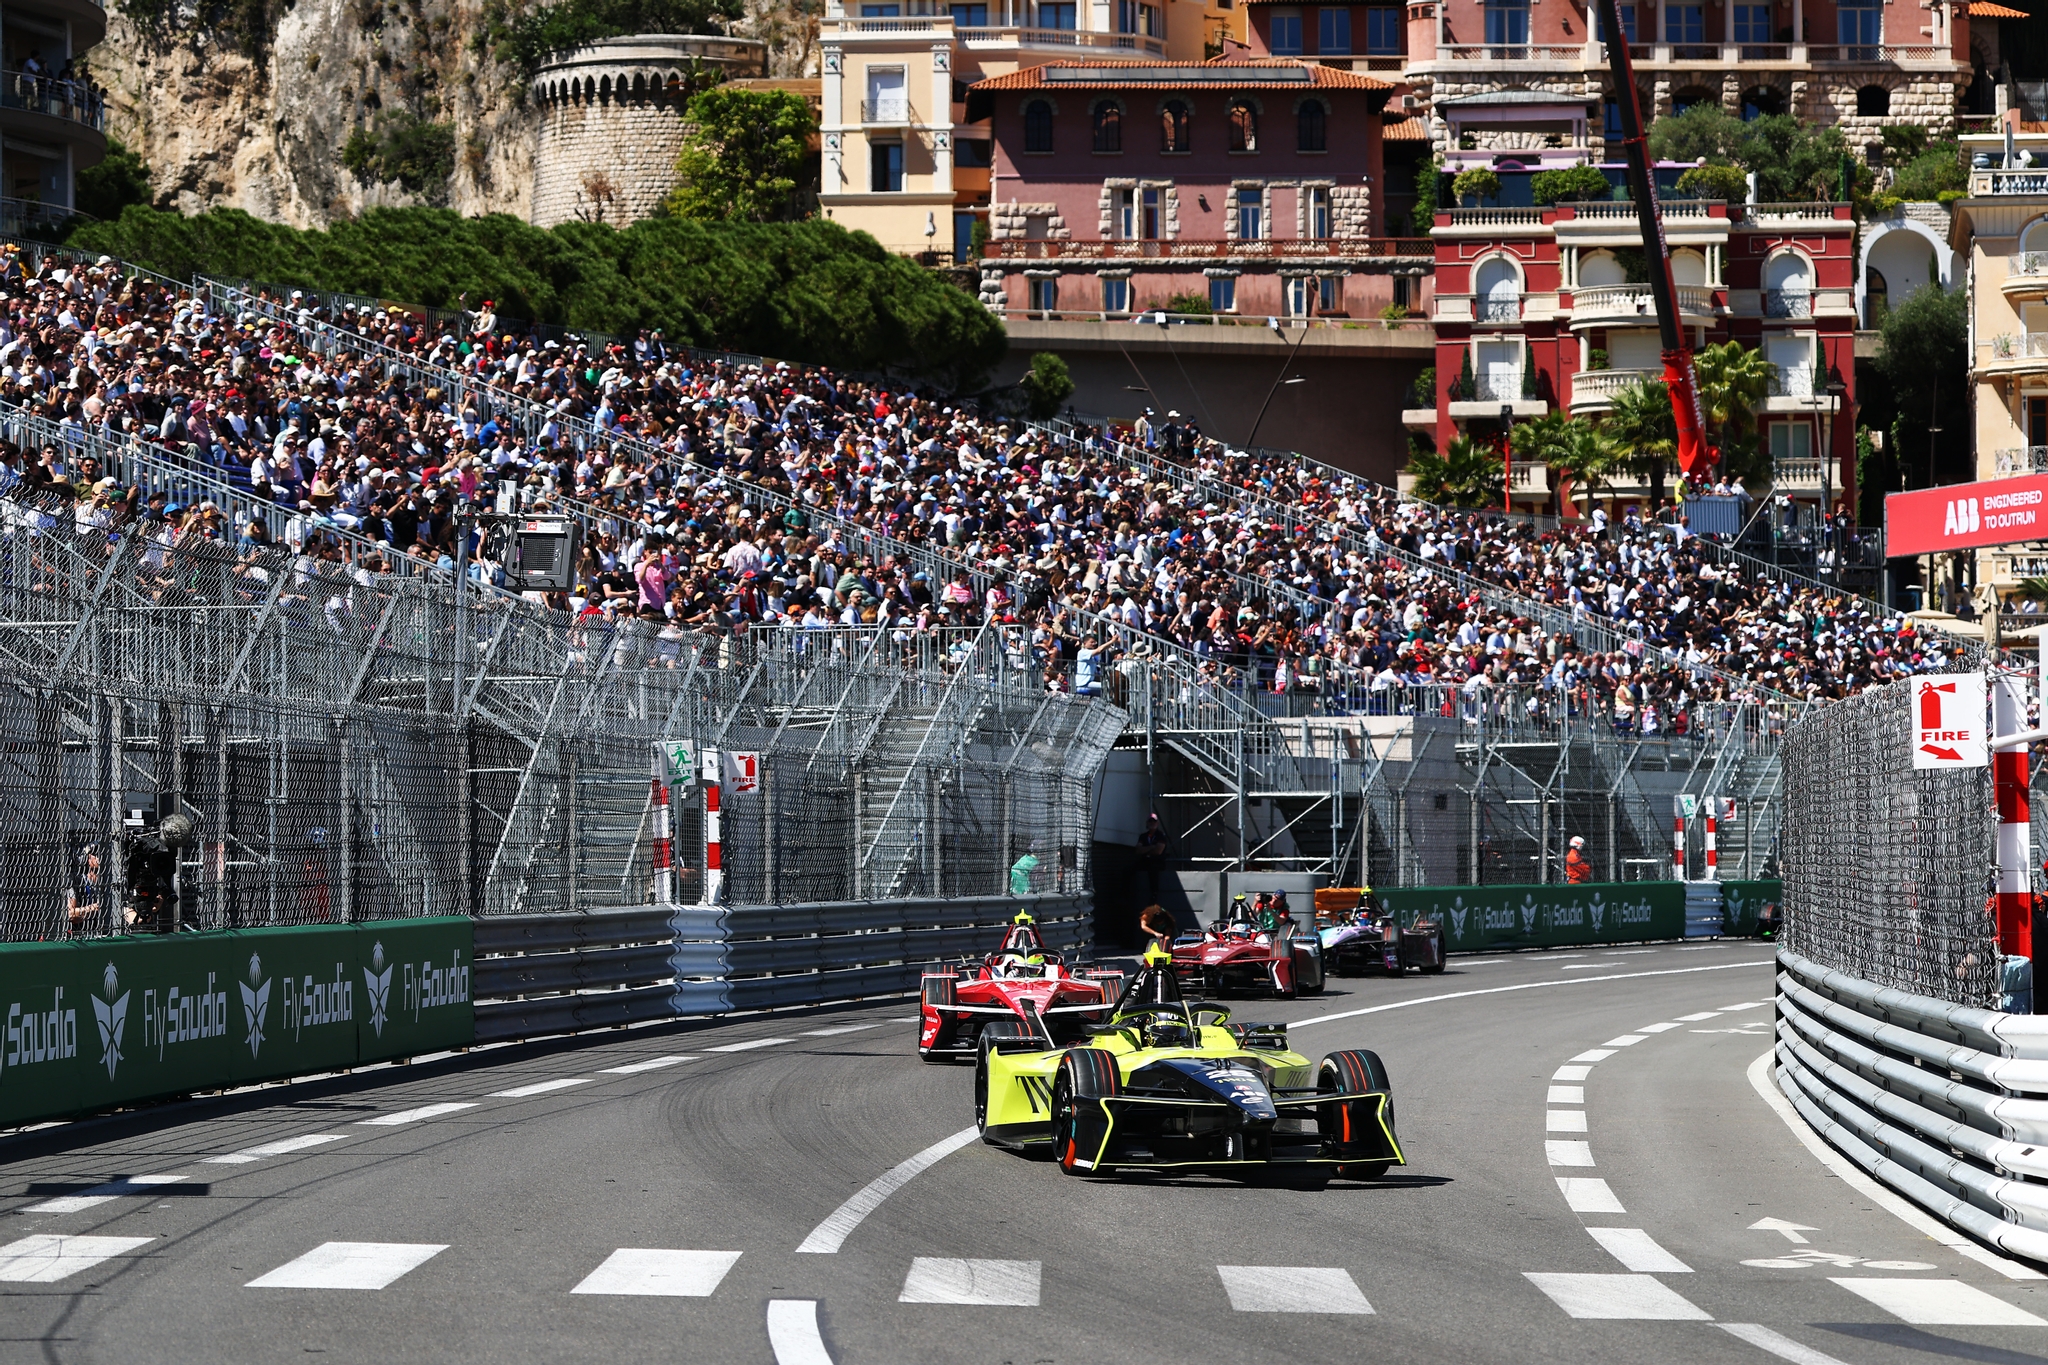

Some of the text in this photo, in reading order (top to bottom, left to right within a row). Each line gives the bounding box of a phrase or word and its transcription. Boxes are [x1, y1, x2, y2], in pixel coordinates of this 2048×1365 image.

[1656, 219, 1669, 259] LEVAGE
[1944, 497, 1980, 536] ABB
[1984, 490, 2043, 510] ENGINEERED
[1985, 510, 2036, 529] TO OUTRUN
[1921, 730, 1970, 742] FIRE
[283, 962, 353, 1043] FlySaudia
[404, 949, 469, 1023] FlySaudia
[144, 971, 227, 1062] FlySaudia
